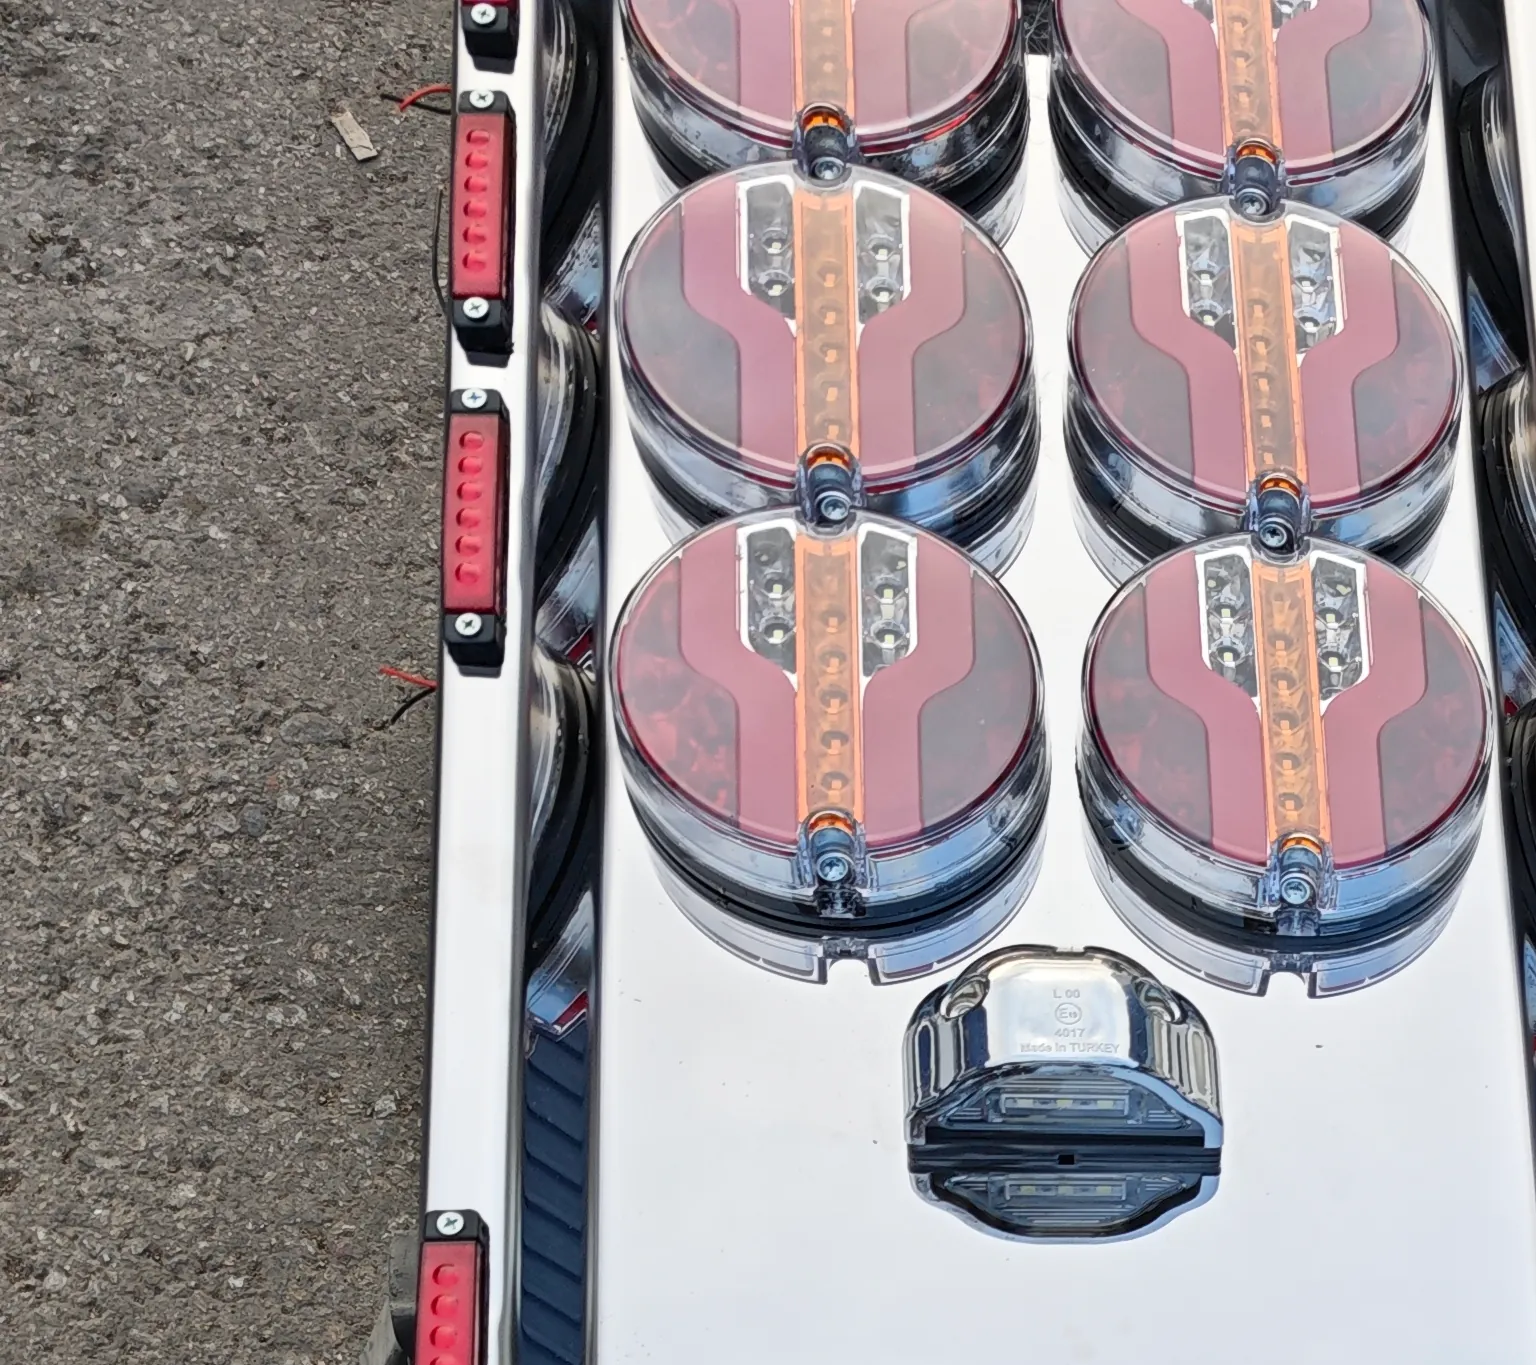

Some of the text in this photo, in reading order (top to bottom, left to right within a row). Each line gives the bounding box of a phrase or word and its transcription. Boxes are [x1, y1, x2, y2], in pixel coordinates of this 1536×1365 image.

[1053, 988, 1081, 999] L 00
[1054, 1028, 1086, 1038] 4017
[1020, 1042, 1053, 1053] Made
[1069, 1042, 1120, 1054] TURKEY
